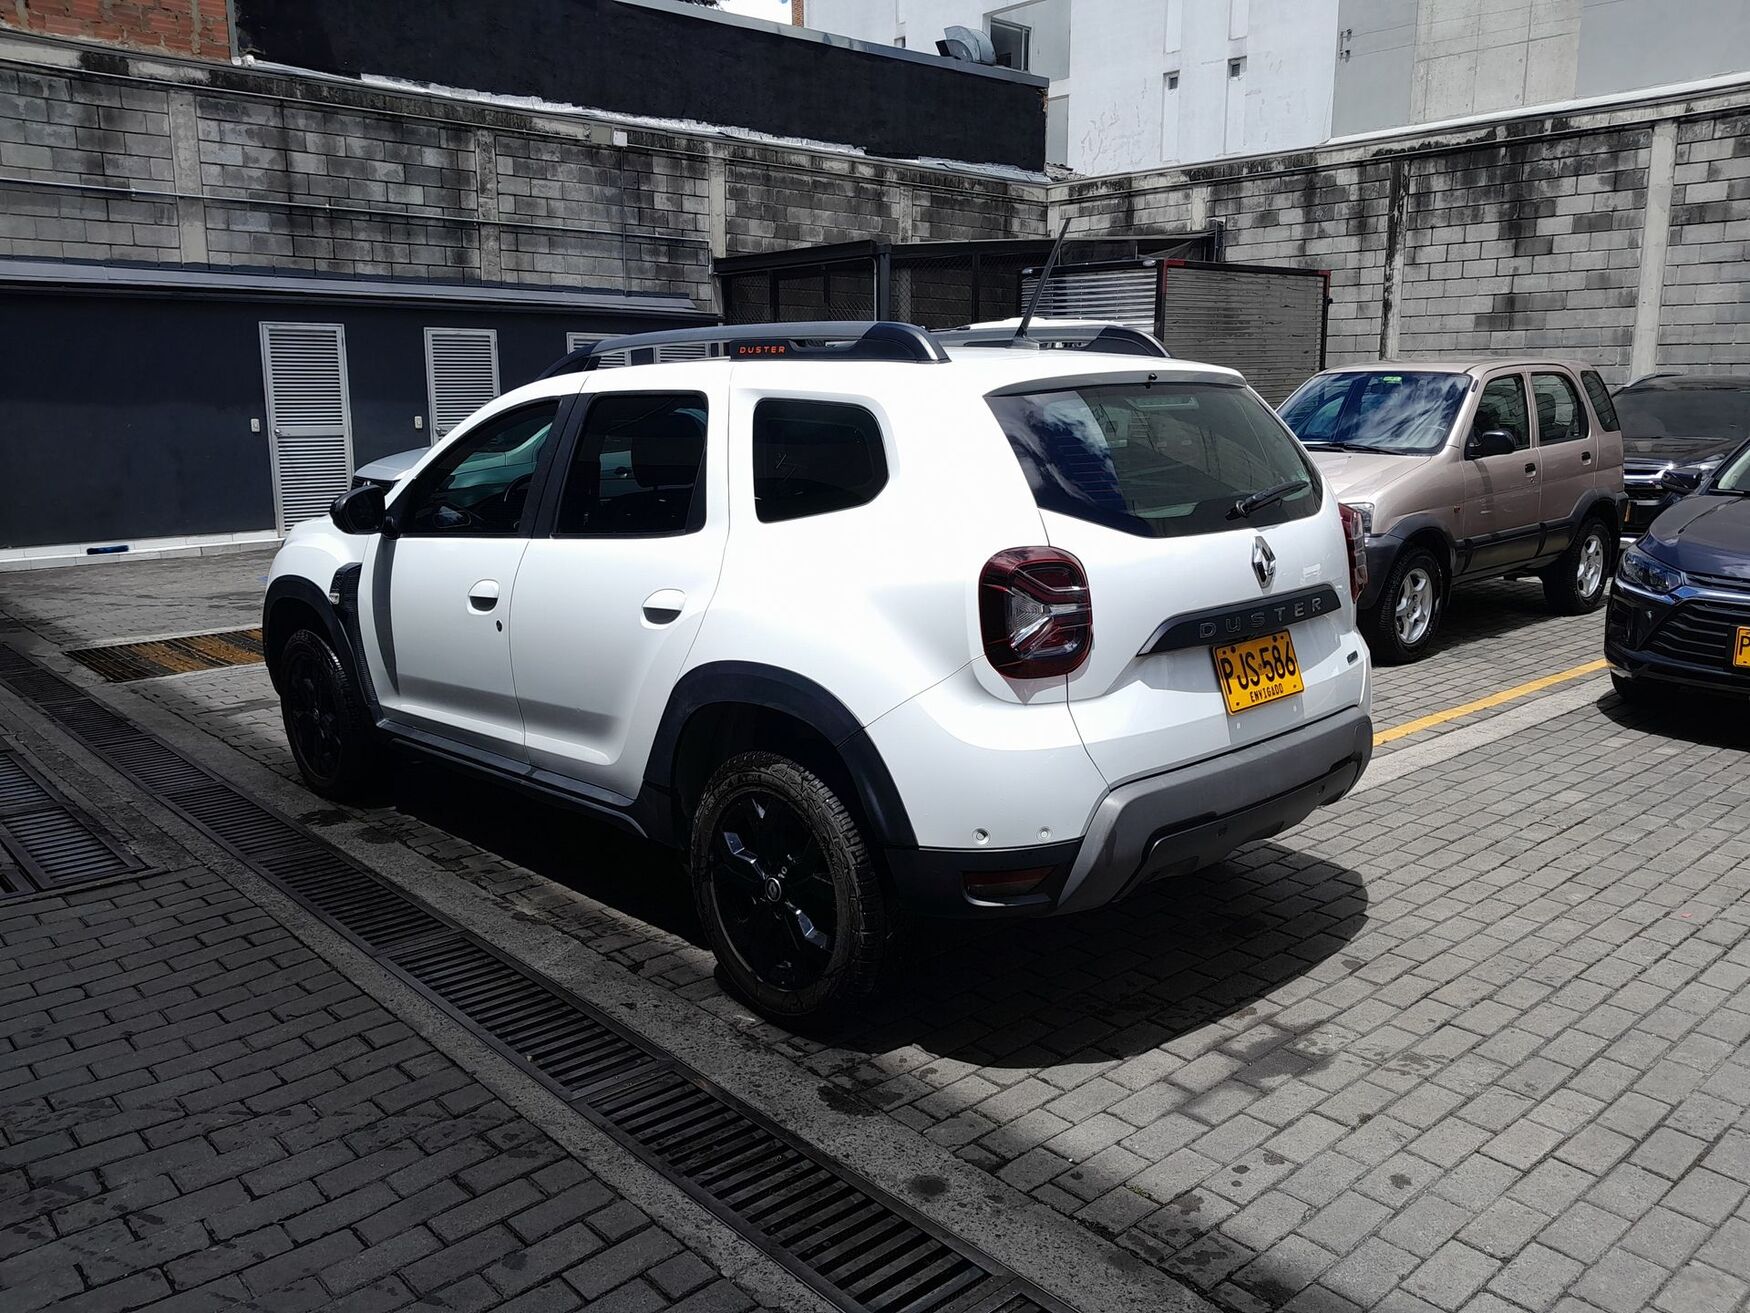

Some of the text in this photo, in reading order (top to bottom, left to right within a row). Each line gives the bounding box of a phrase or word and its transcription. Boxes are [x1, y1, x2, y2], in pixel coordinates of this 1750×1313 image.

[739, 346, 786, 354] DUSTER
[1200, 597, 1322, 638] DUSTER
[1249, 683, 1284, 702] ENVIGADO
